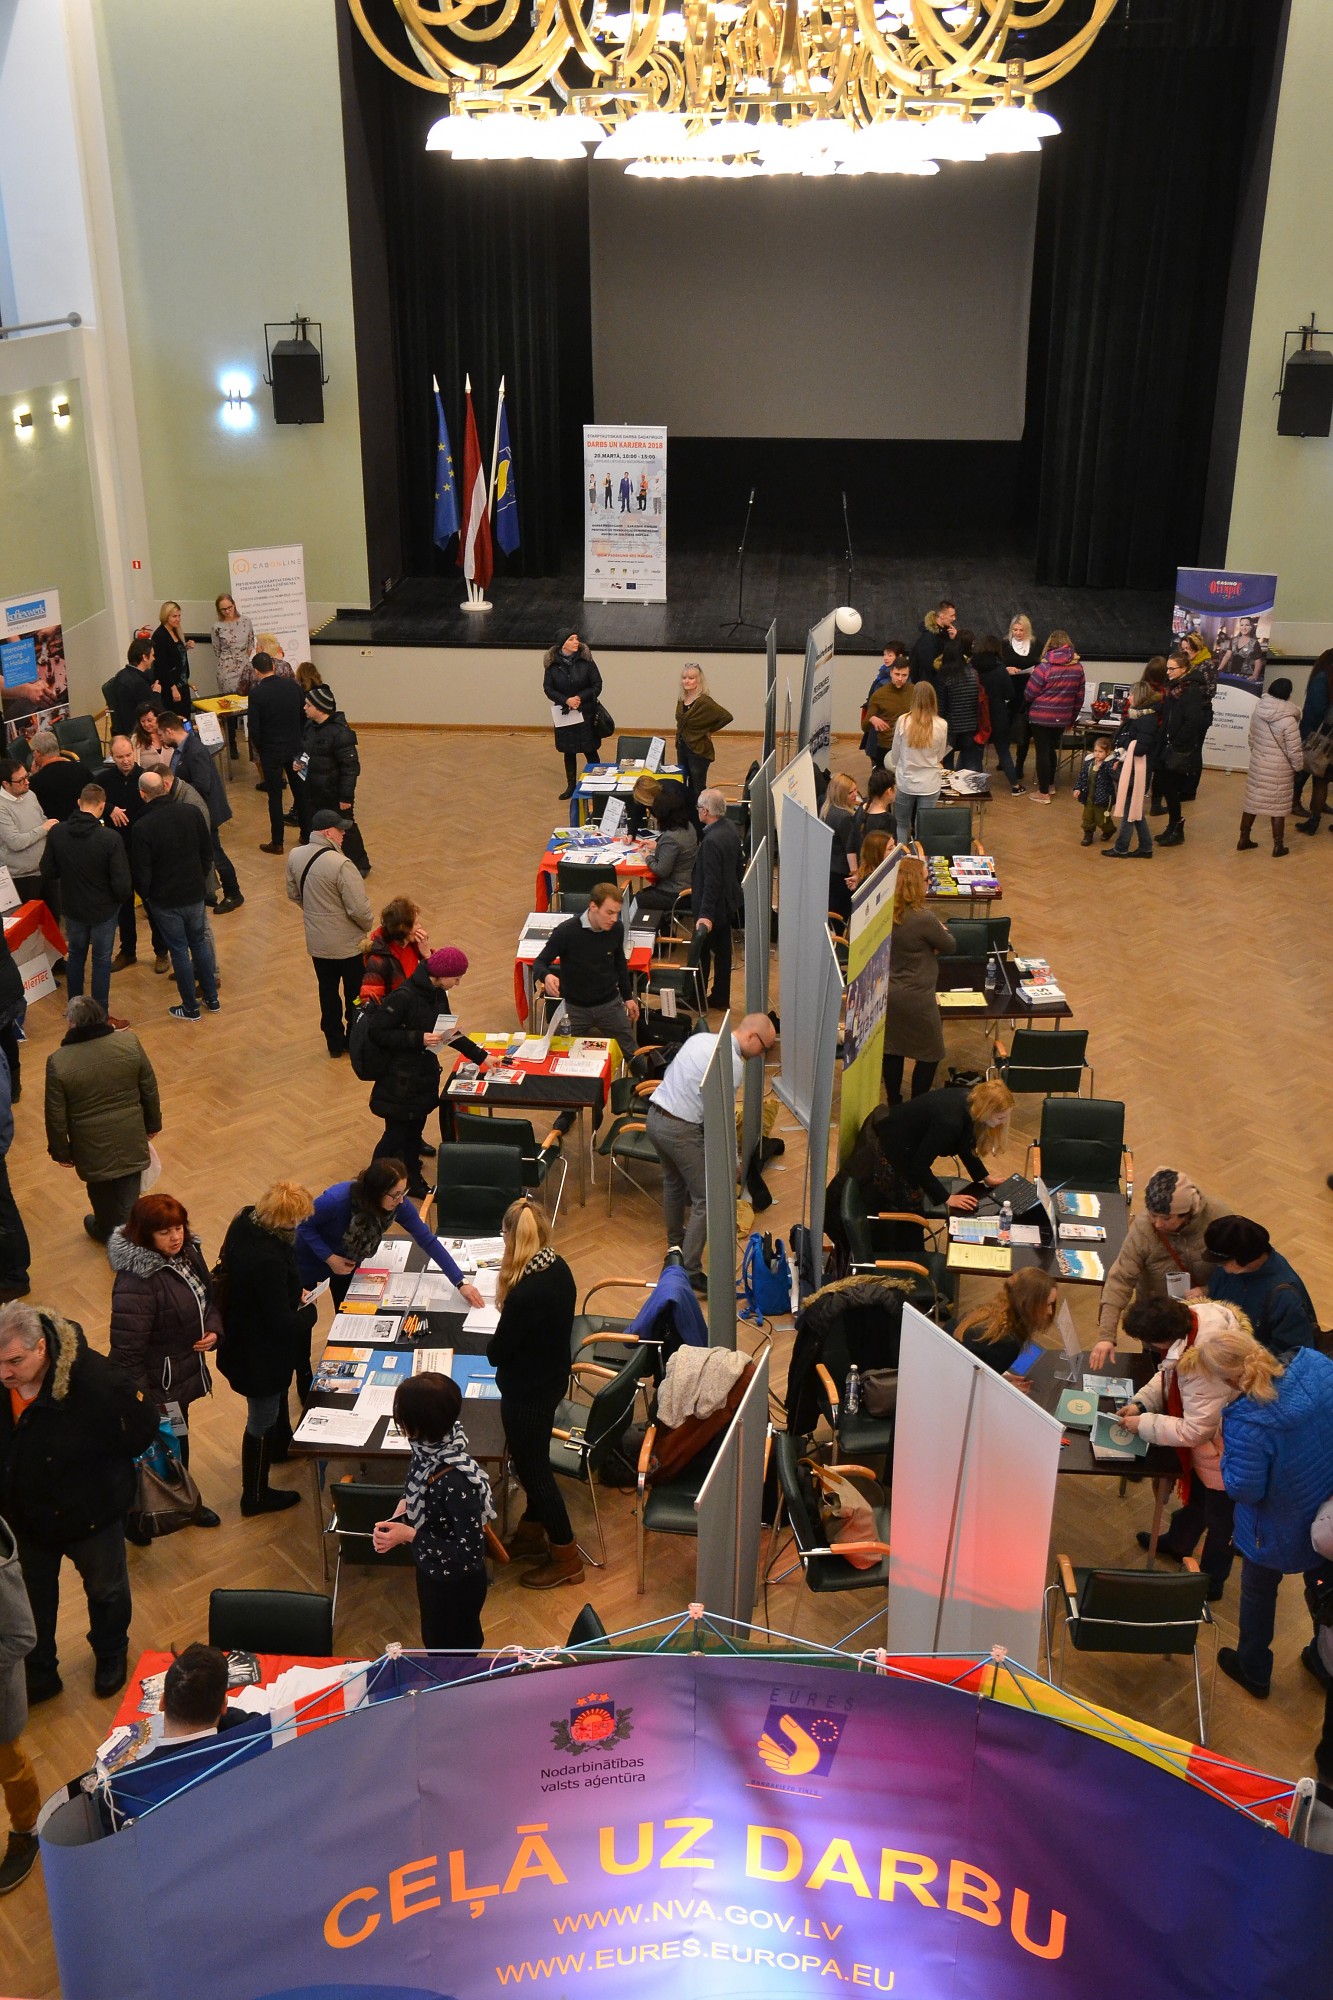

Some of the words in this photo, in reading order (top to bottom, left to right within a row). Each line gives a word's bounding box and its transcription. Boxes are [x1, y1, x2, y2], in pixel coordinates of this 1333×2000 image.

[769, 1687, 854, 1711] EURES
[540, 1757, 644, 1779] Nodarbinātības
[540, 1779, 580, 1793] valsts
[584, 1772, 646, 1789] aģentūra
[322, 1823, 568, 1950] CEĻĀ
[599, 1816, 714, 1876] UZ
[745, 1825, 1068, 1961] DARBU
[553, 1899, 843, 1942] WWW.NVA.GOV.LV
[496, 1938, 896, 1992] WWW.EURES.EUROPA.EU
